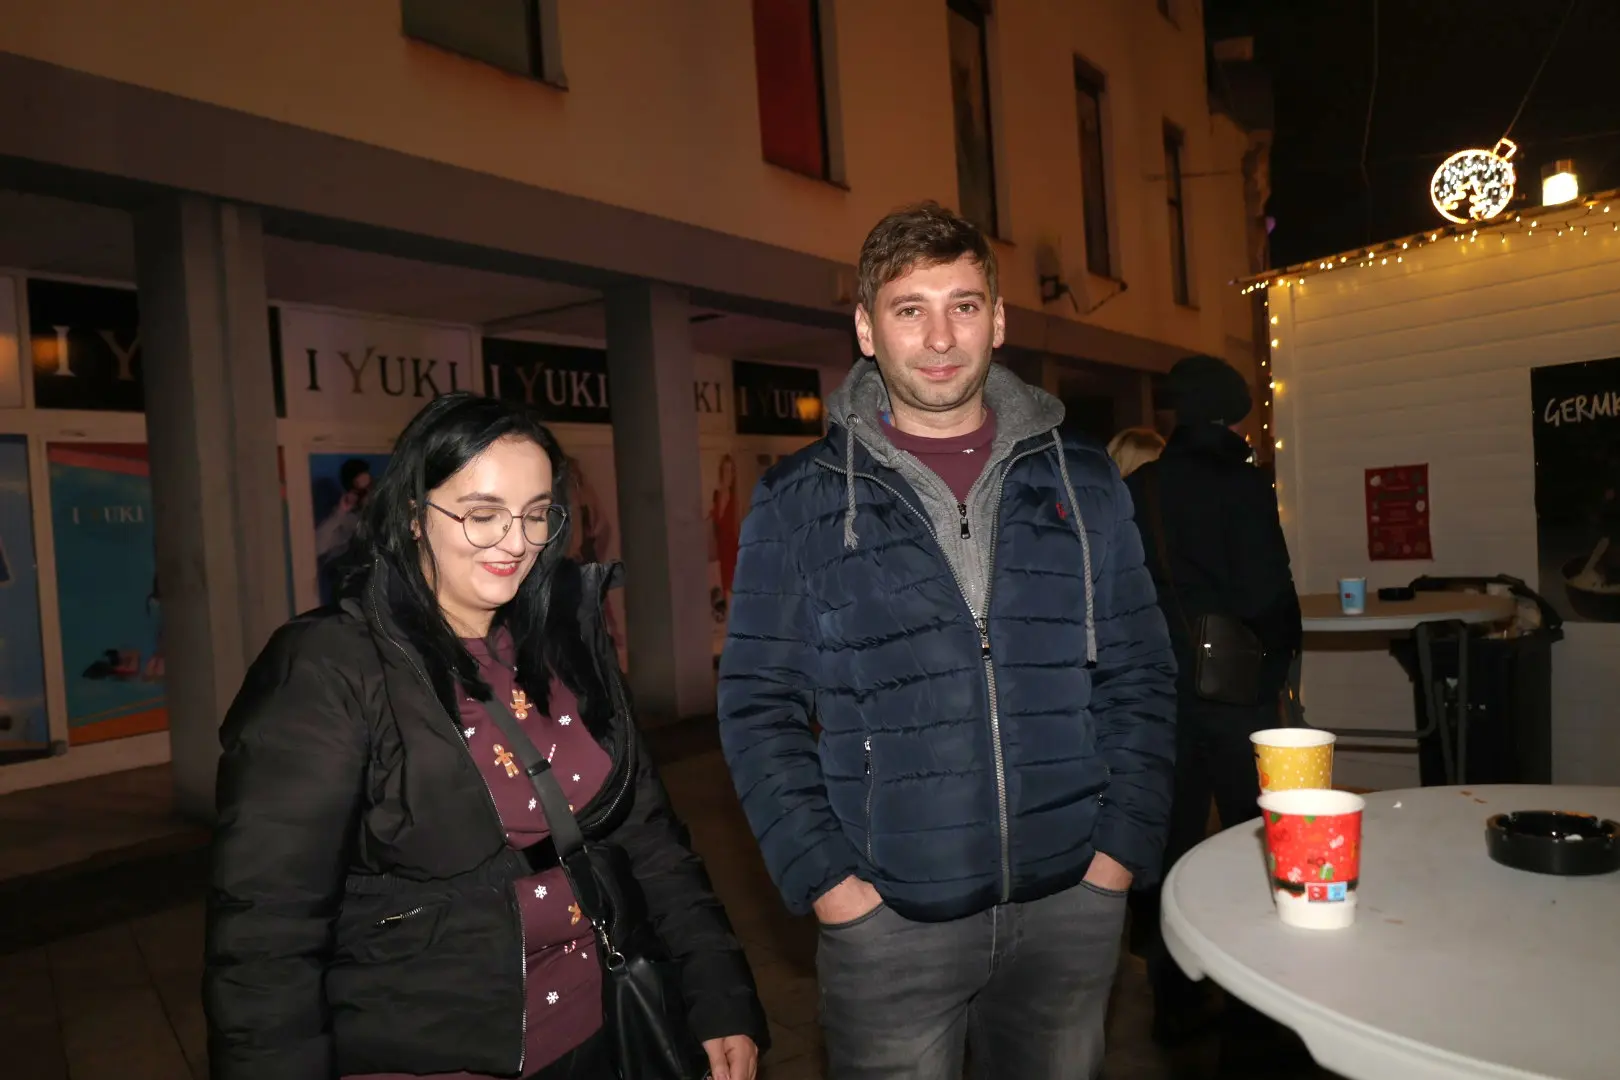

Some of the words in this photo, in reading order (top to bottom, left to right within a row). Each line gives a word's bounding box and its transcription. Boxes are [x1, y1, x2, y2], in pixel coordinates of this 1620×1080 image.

[52, 324, 77, 377] I
[305, 349, 321, 391] I
[338, 346, 458, 398] YUKI
[488, 363, 502, 400] I
[514, 361, 610, 408] YUKI
